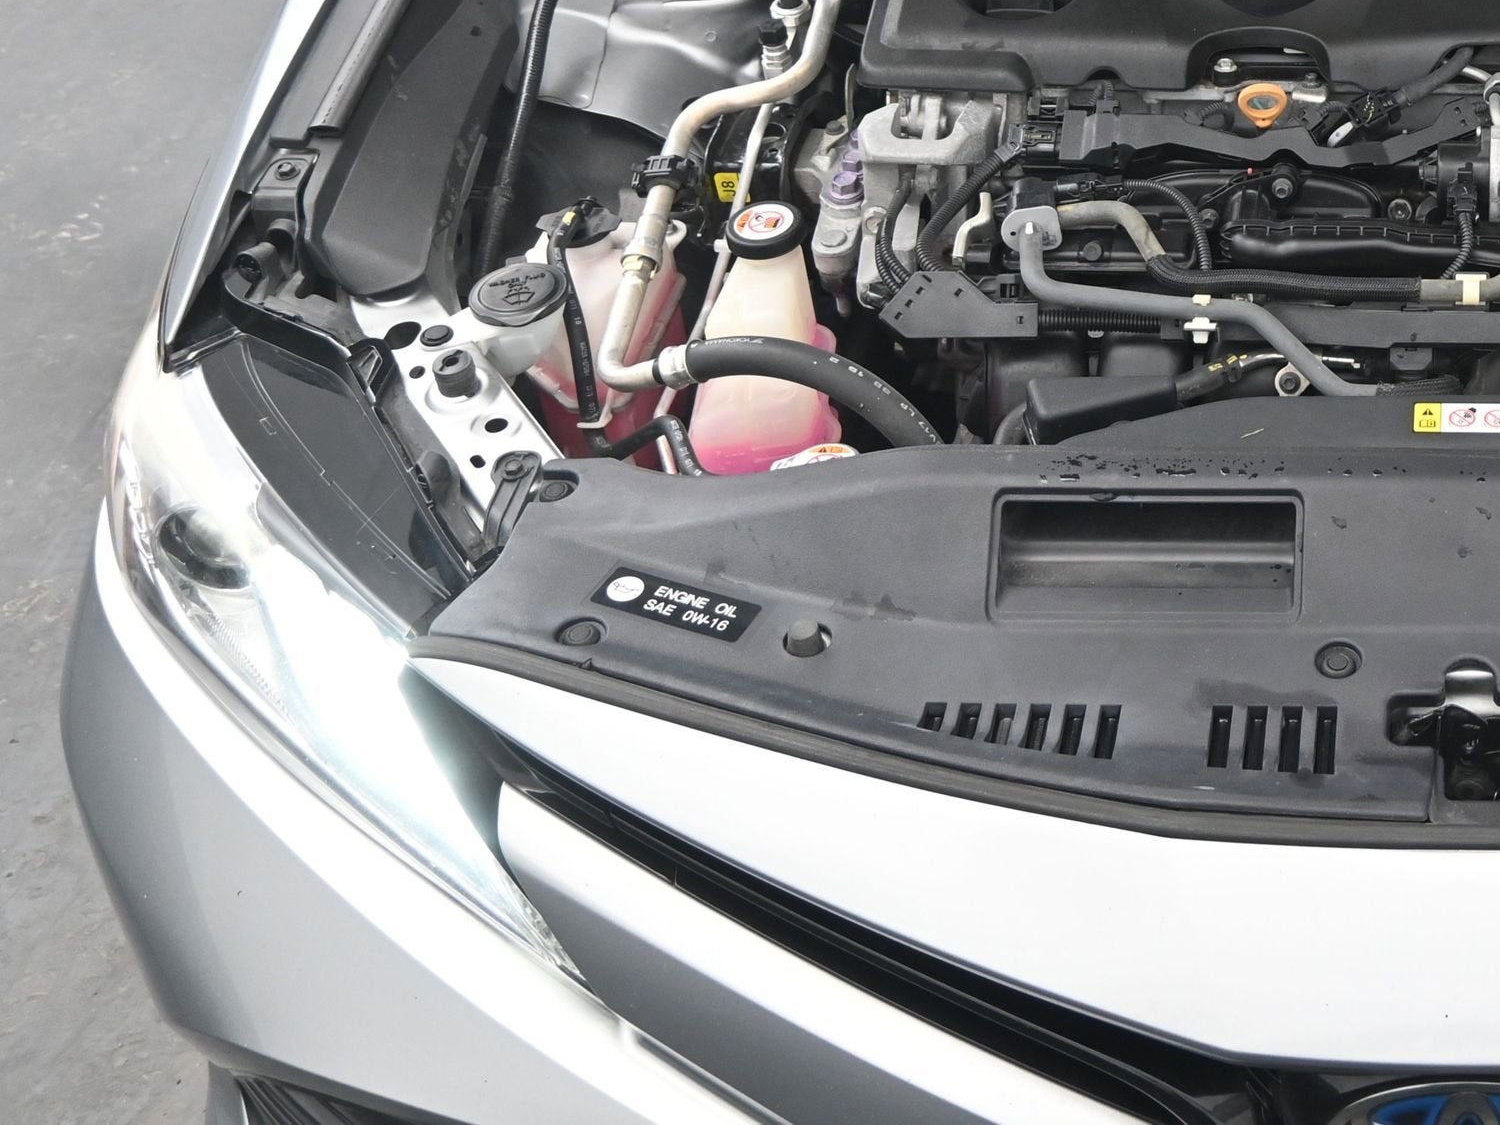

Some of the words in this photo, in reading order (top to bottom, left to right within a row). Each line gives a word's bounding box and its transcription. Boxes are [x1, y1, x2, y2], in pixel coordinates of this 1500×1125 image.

[642, 598, 678, 616] SAE
[681, 609, 730, 632] 0W-16
[653, 585, 710, 610] ENGINE
[714, 597, 738, 619] OIL
